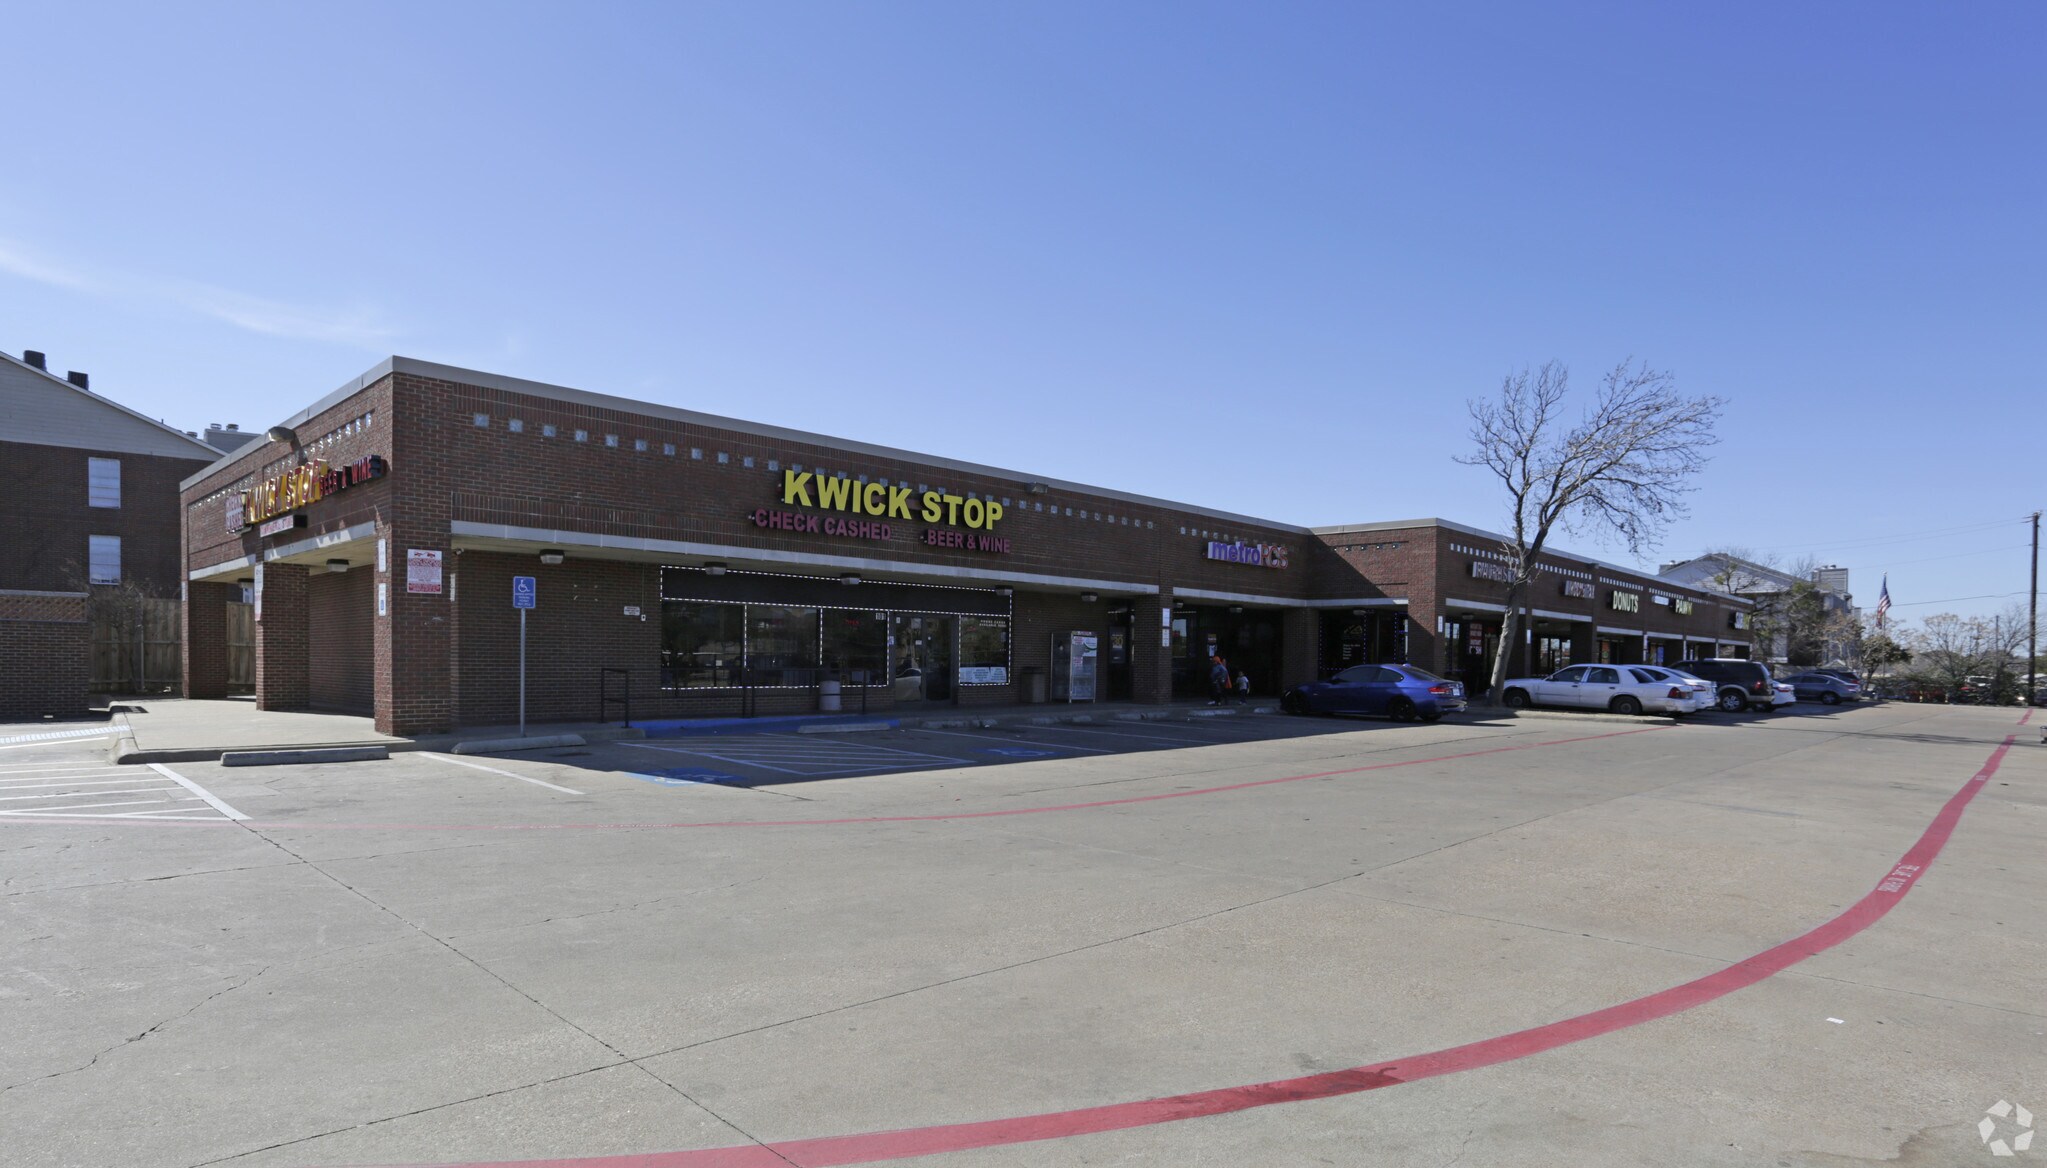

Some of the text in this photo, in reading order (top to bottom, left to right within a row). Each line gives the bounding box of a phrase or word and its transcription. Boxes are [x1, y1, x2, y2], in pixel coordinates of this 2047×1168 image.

[286, 459, 328, 509] STOP
[784, 470, 1004, 530] KWICK STOP
[755, 509, 892, 541] CHECK CASHED
[928, 530, 1011, 553] BEER & WINE
[1208, 541, 1289, 570] metroPCS
[1612, 590, 1639, 613] DONUTS
